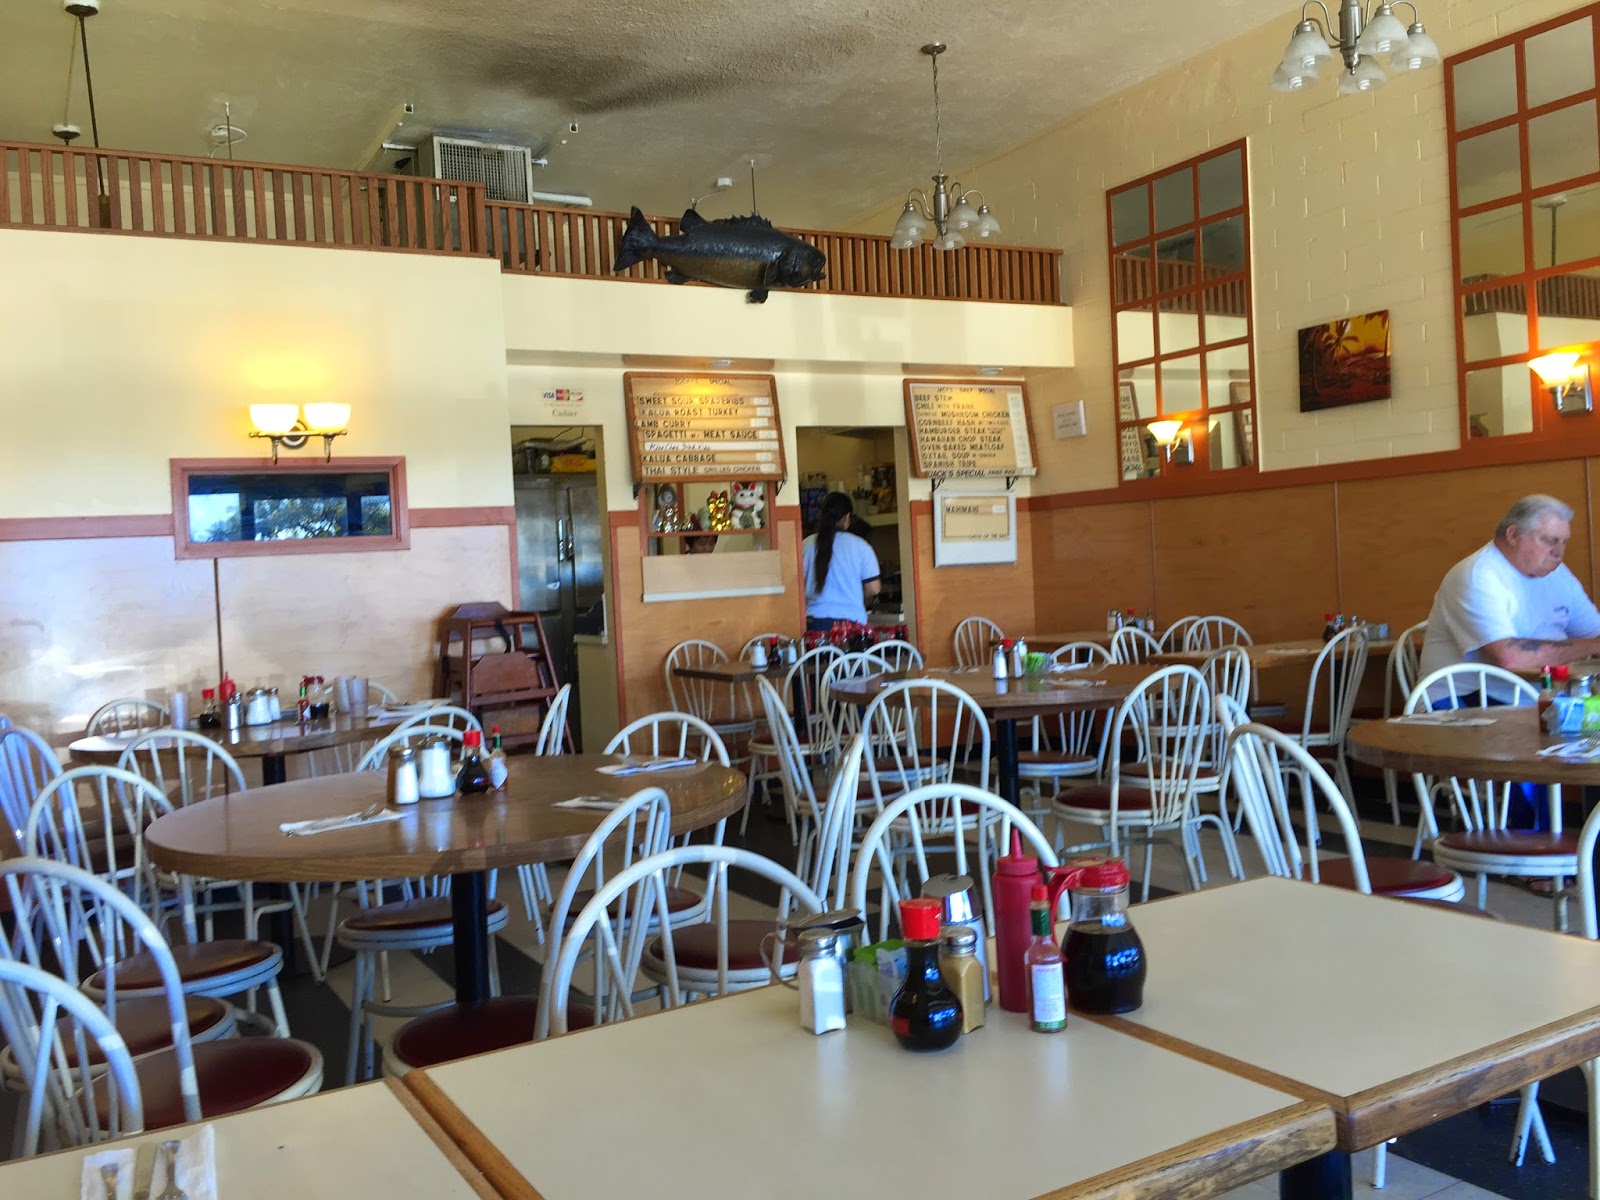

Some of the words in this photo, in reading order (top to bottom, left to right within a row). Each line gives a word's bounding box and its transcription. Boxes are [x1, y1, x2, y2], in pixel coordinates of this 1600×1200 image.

[639, 397, 667, 405] SWEET
[674, 408, 703, 416] ROAST
[709, 408, 739, 416] TURKEY
[634, 420, 659, 428] LAMB
[663, 420, 691, 428] CURRY
[645, 430, 687, 439] SPAGETTI
[704, 430, 726, 438] MEAT
[730, 430, 758, 439] SAUCE
[642, 454, 671, 462] KALUA
[676, 454, 717, 462] CABBAGE
[644, 467, 665, 475] THAI
